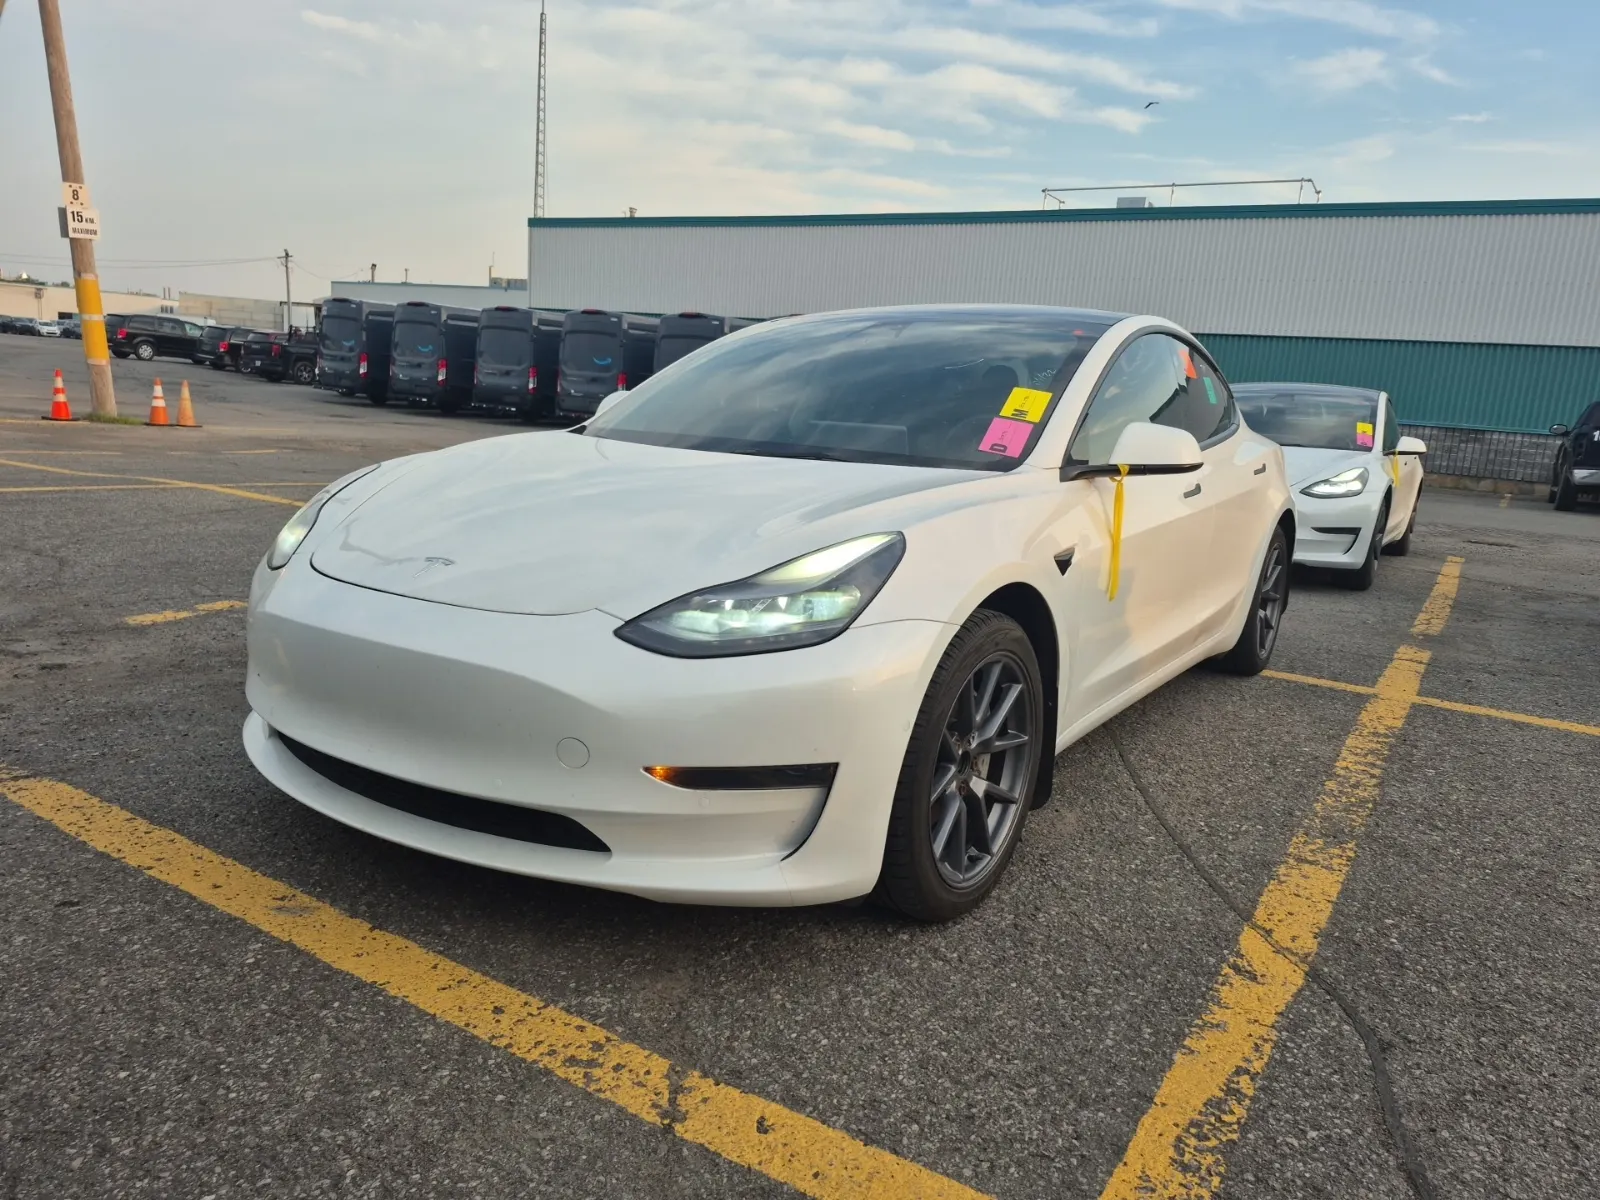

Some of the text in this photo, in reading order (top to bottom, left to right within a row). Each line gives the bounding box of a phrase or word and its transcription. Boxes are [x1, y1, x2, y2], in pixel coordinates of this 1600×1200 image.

[72, 189, 79, 201] 8
[70, 211, 83, 223] 15
[72, 227, 98, 236] MAXIMUM
[1010, 408, 1029, 419] M
[989, 443, 1008, 454] D
